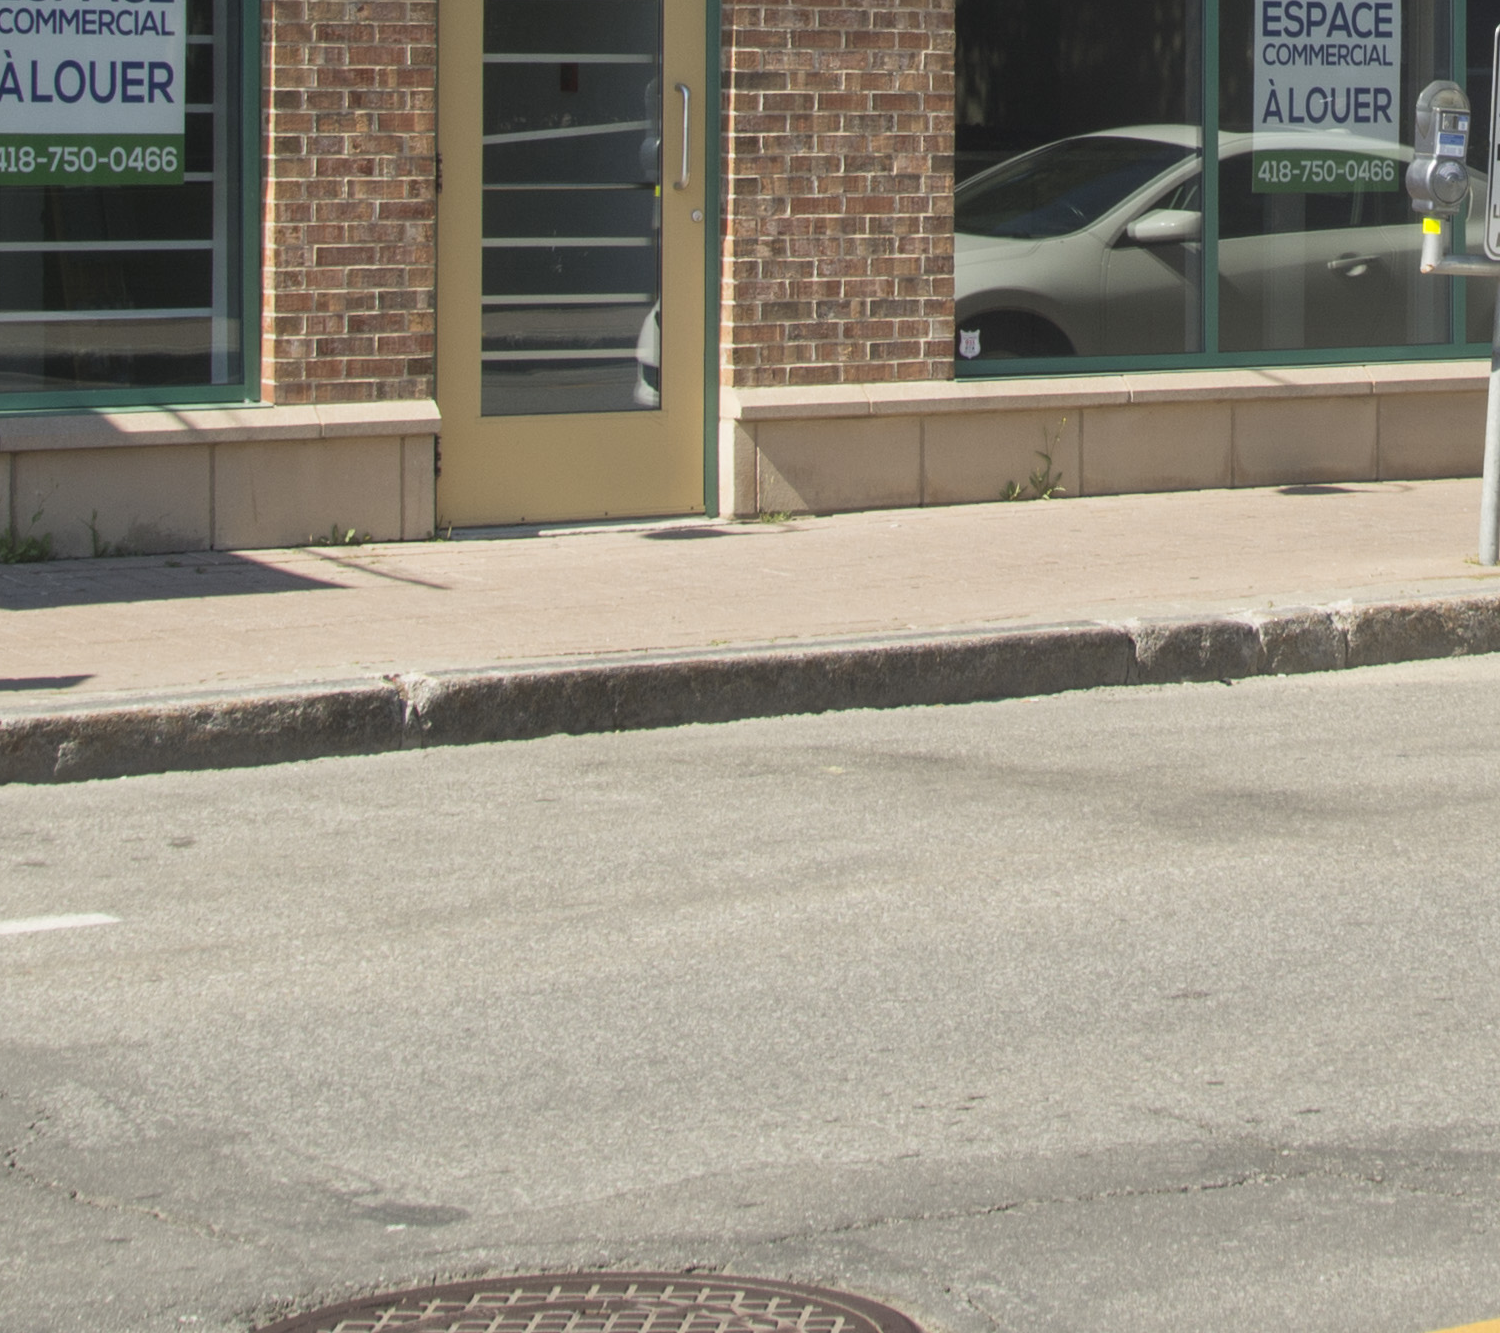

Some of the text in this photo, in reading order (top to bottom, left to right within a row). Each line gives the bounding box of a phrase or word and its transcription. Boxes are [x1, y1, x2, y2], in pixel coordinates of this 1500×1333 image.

[1262, 0, 1394, 39] ESPACE
[1262, 42, 1394, 67] COMMERCIAL
[30, 59, 175, 104] LOUER
[1262, 78, 1393, 125] À LOUER
[1257, 159, 1396, 183] 418-750-0466
